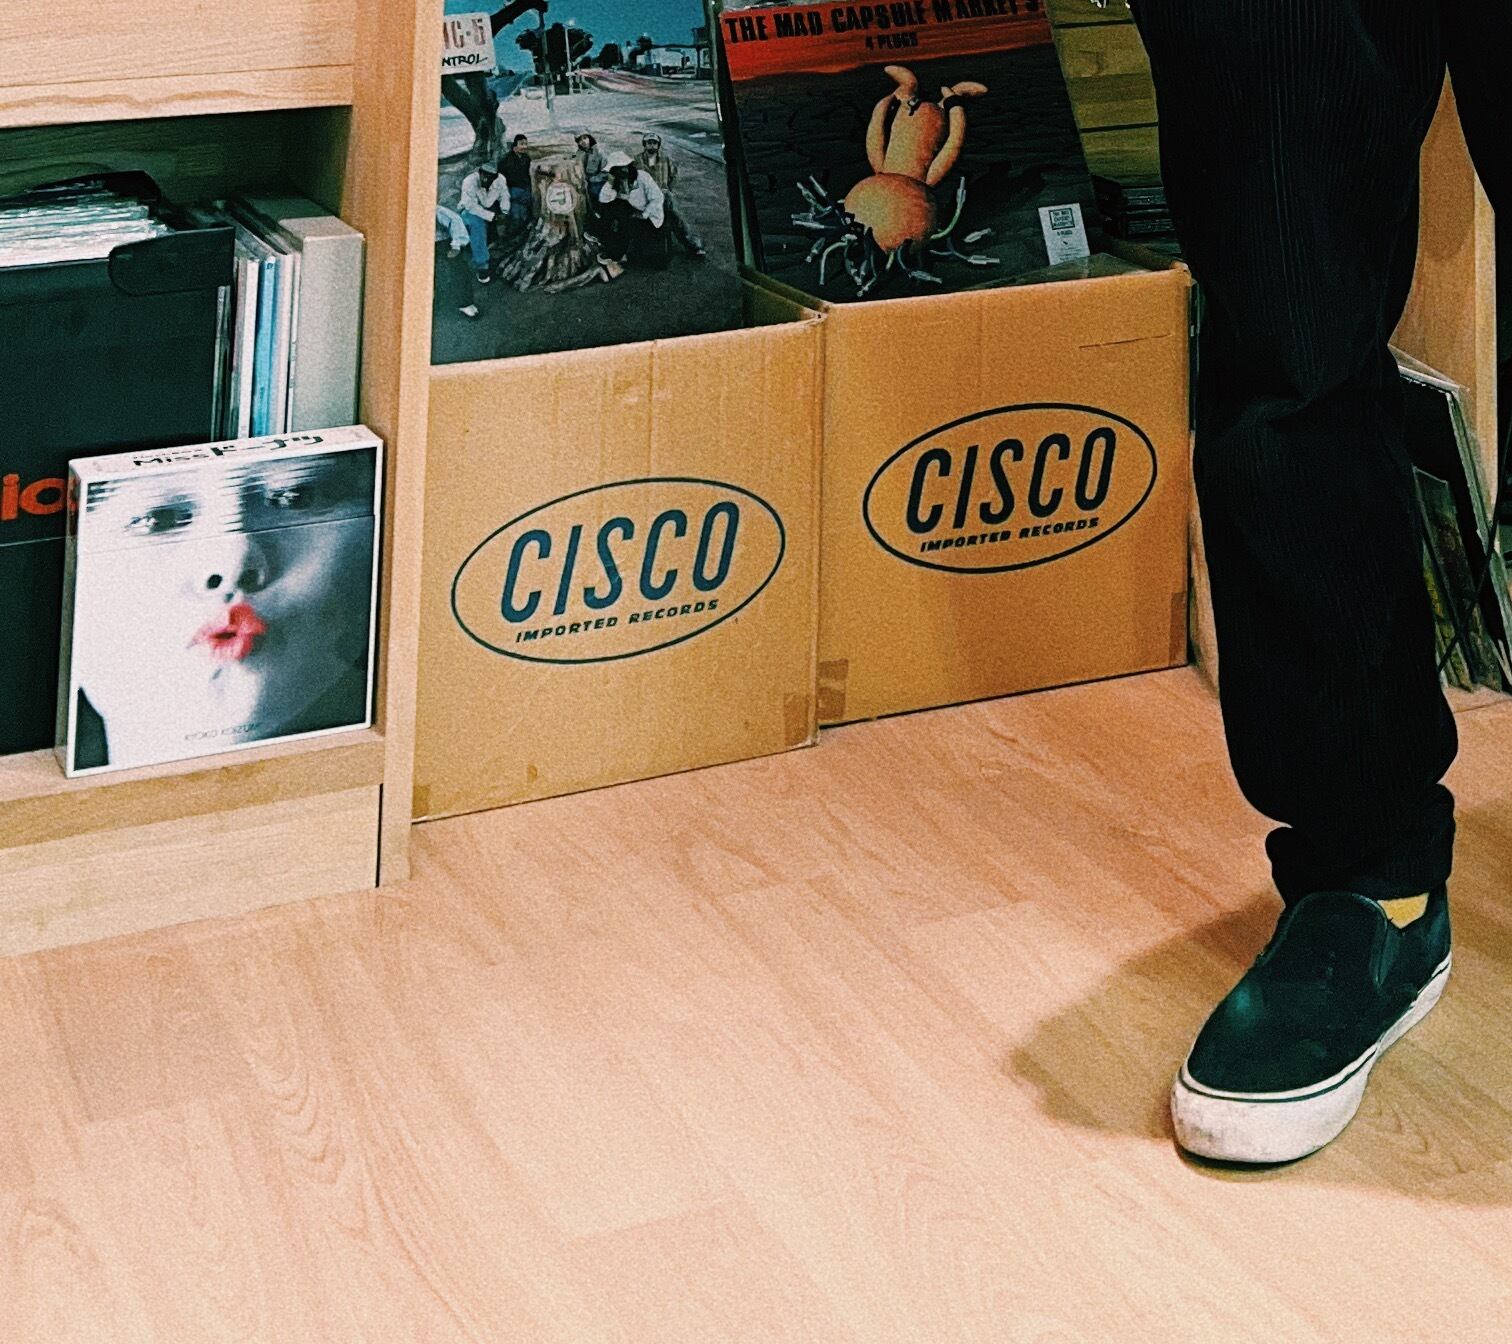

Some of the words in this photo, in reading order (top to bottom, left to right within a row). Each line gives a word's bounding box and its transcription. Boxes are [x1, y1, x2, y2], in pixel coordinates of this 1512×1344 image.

[724, 15, 770, 45] THE
[773, 11, 824, 39] MAD
[831, 0, 929, 34] CAPSULE
[876, 32, 919, 50] PLUGS
[906, 425, 1117, 535] CISCO
[920, 529, 1012, 553] IMPORTED
[1018, 516, 1100, 541] RECORDS
[500, 500, 741, 624] CISCO
[515, 615, 618, 644] IMPORTED
[628, 598, 720, 627] RECORDS
